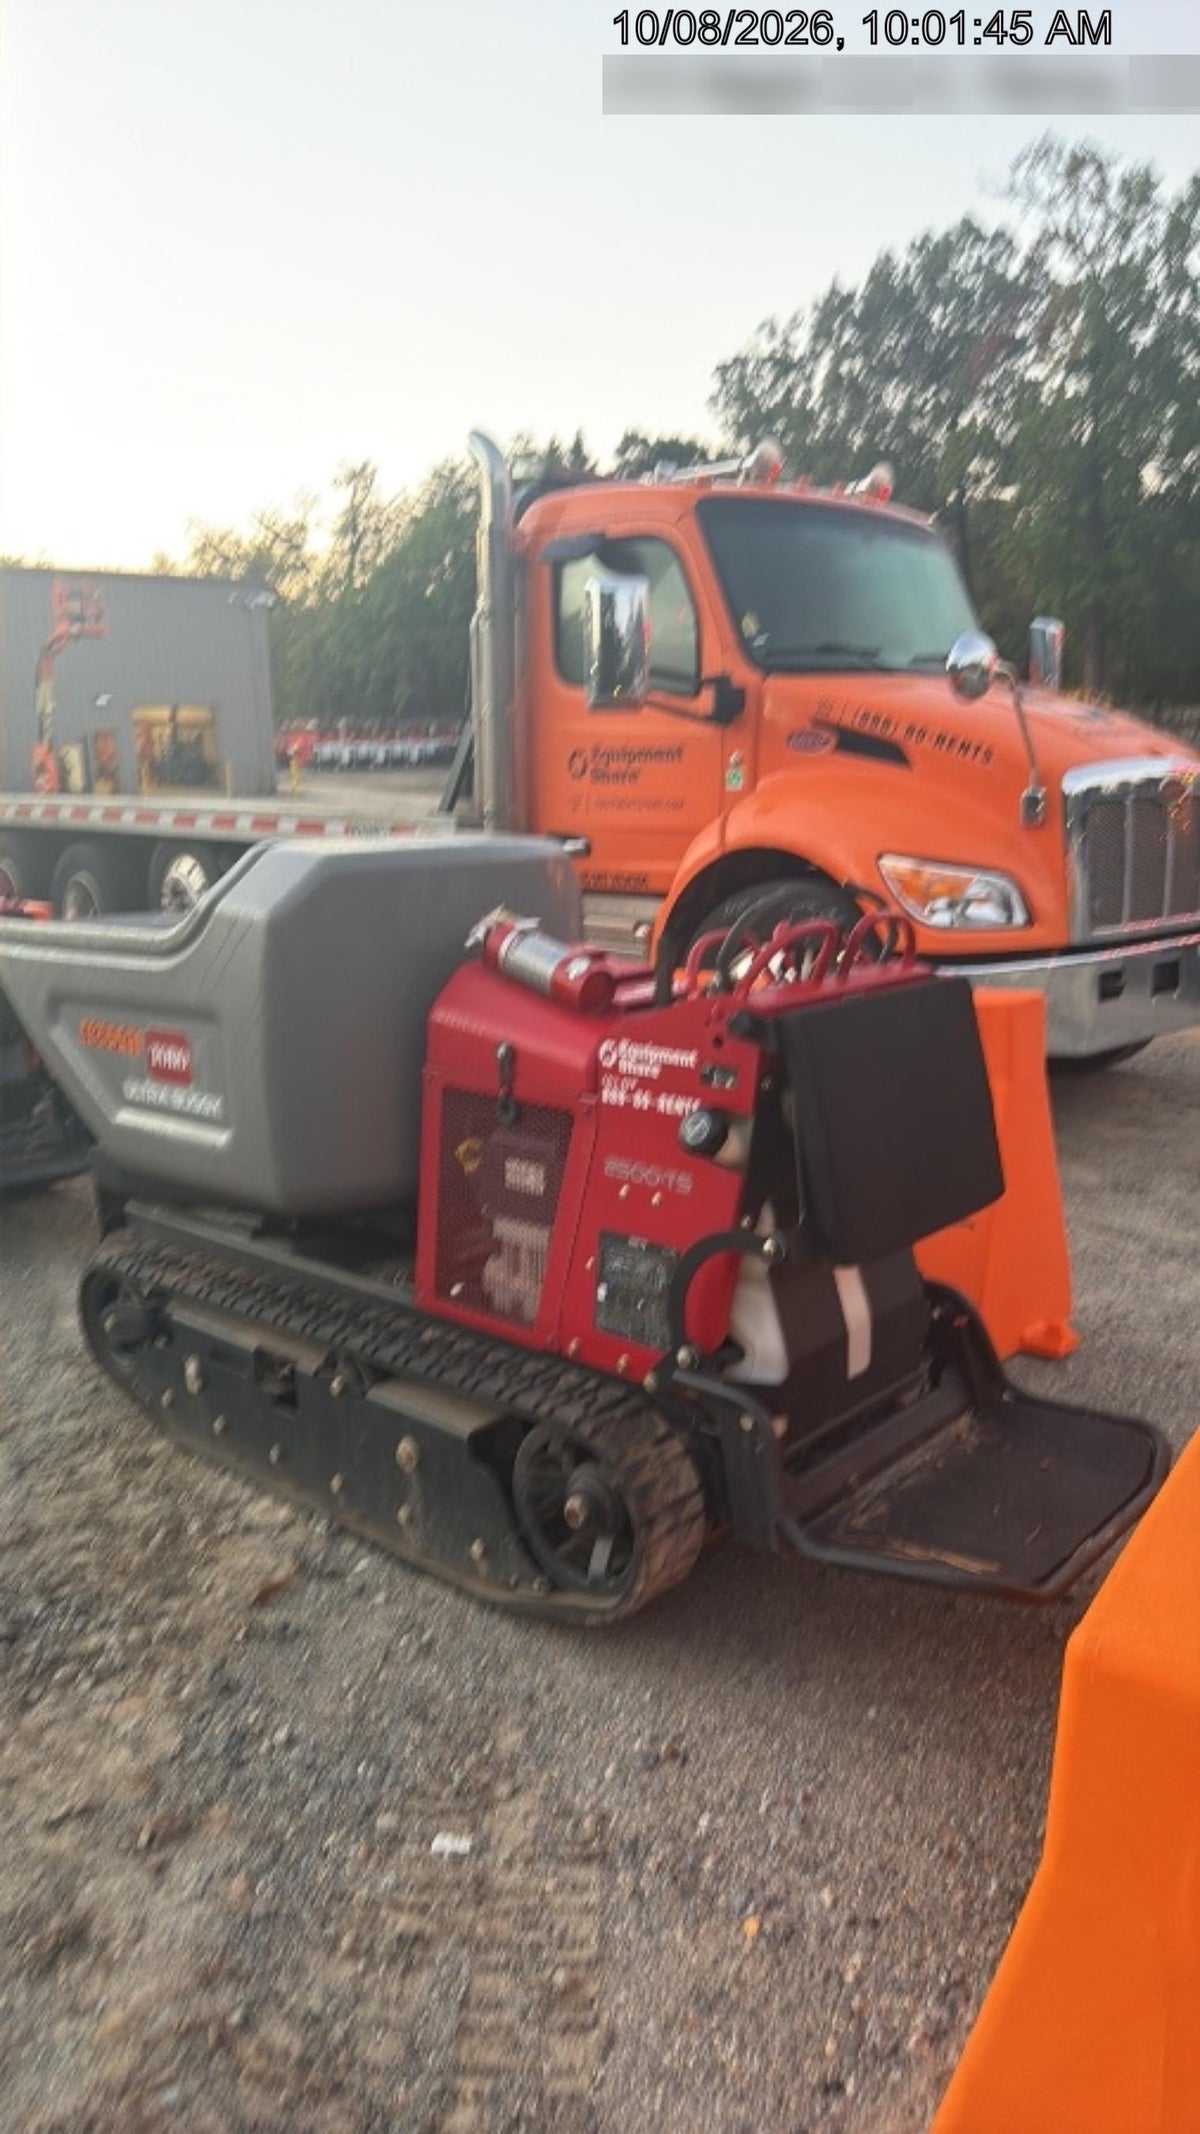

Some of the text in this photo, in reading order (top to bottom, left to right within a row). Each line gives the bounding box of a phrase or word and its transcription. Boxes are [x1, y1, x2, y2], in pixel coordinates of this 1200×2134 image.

[590, 743, 685, 766] Equipment
[590, 767, 640, 786] Share
[618, 1039, 698, 1067] Equipment
